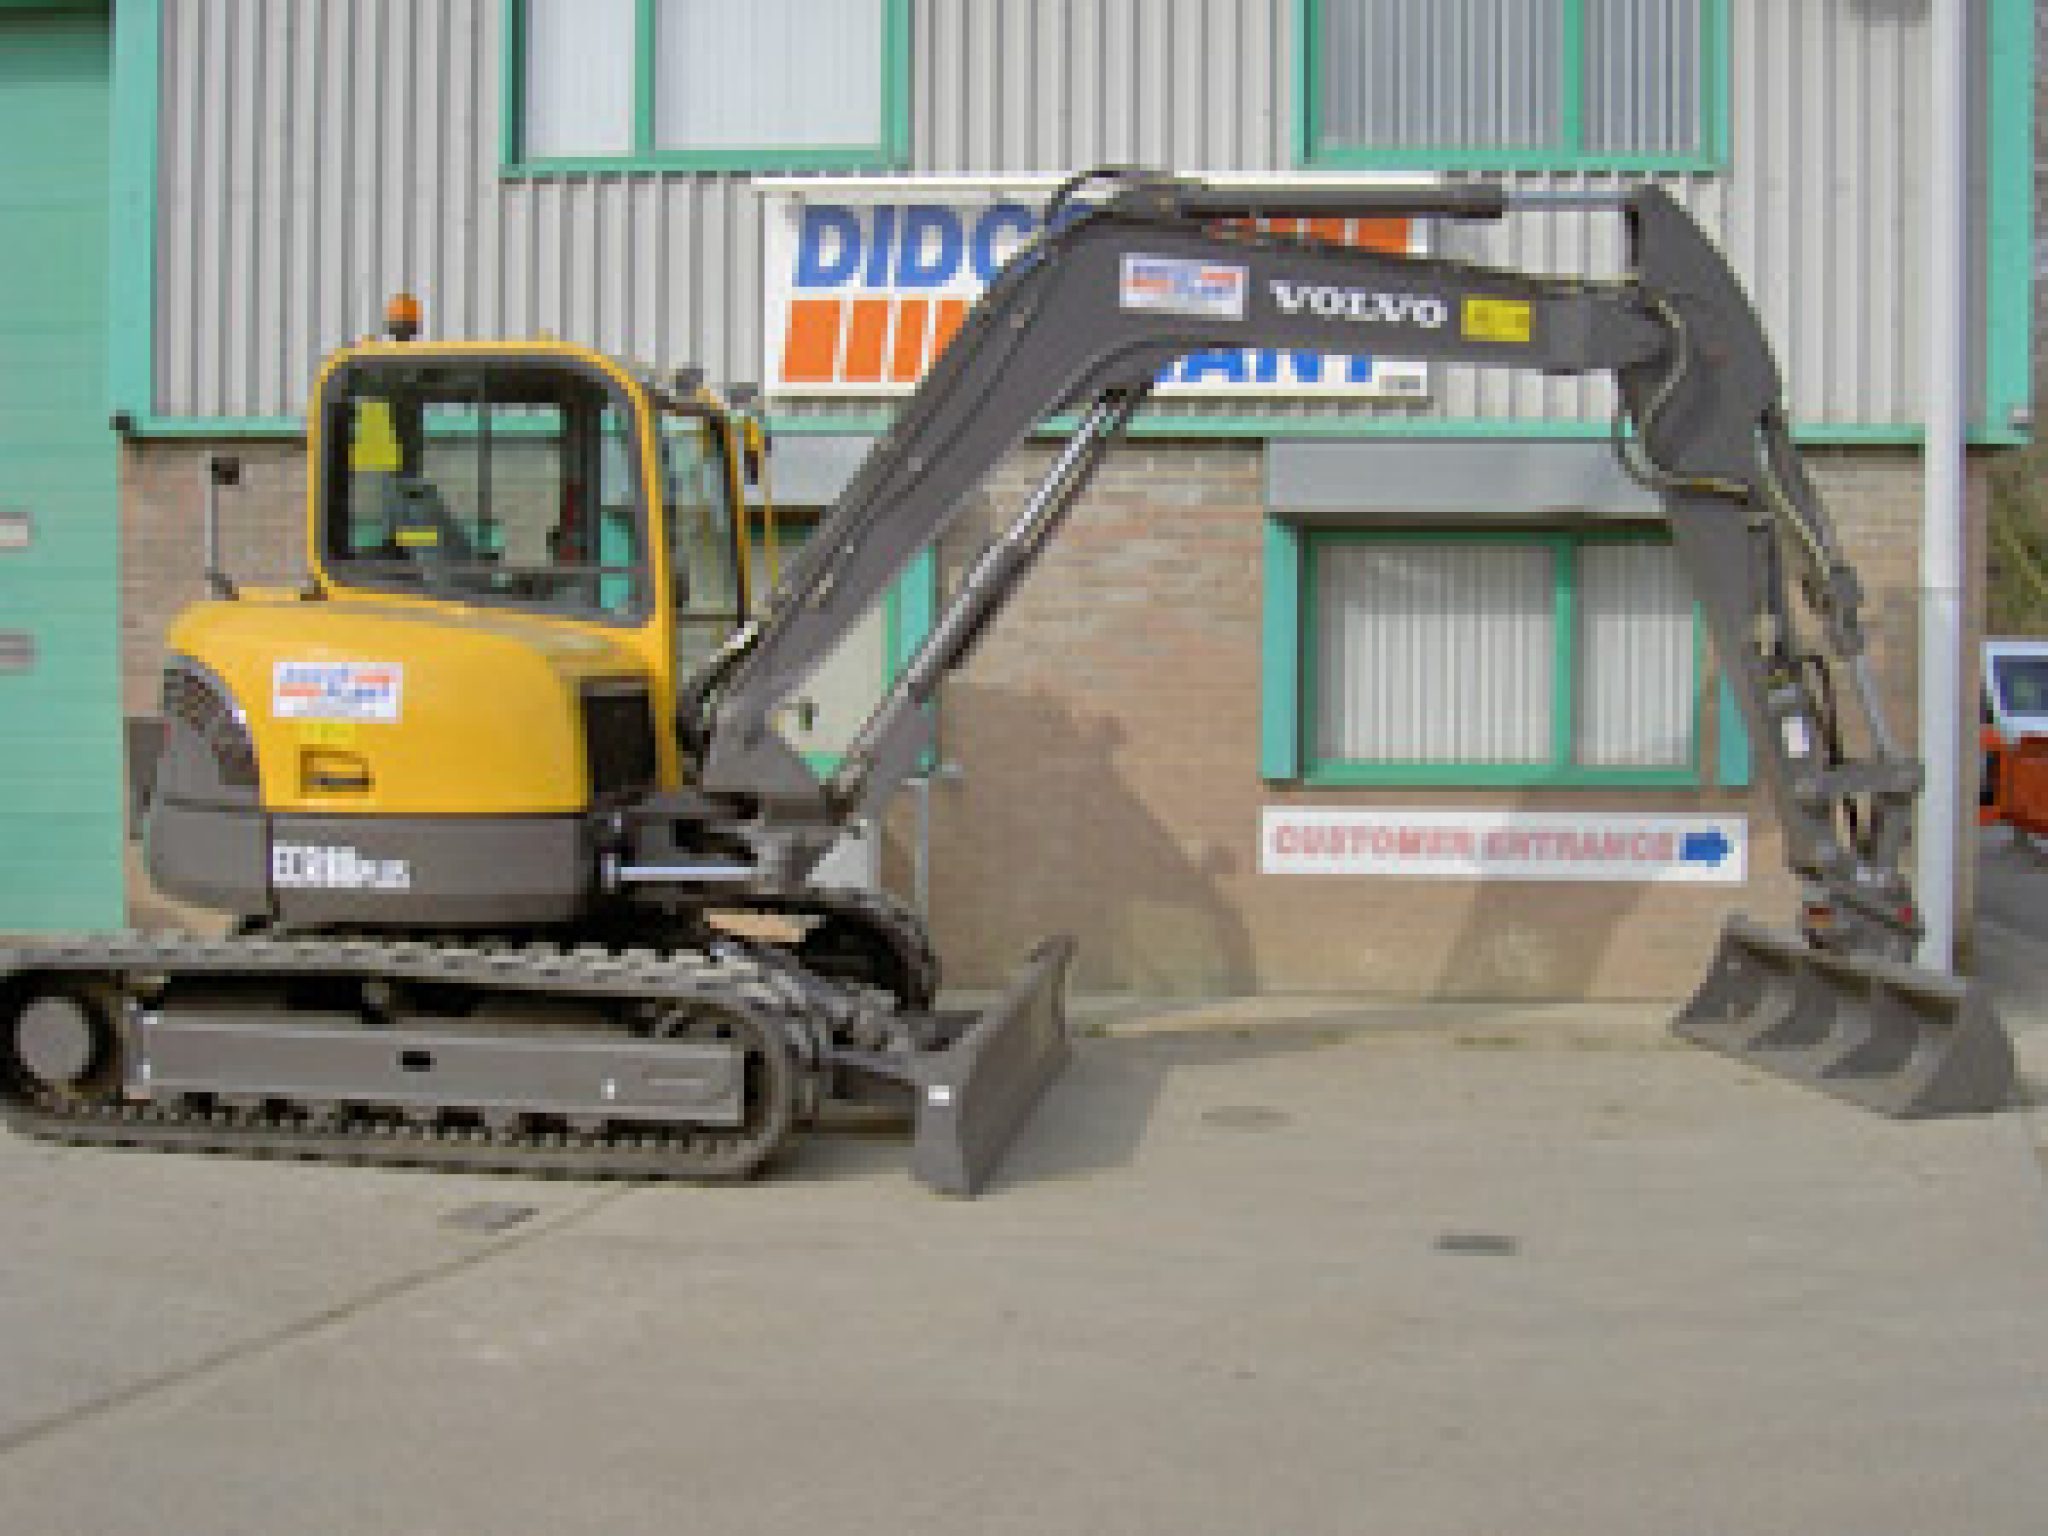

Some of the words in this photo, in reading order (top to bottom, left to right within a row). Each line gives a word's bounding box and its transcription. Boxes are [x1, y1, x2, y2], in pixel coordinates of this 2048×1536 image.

[797, 203, 1094, 288] DIDC
[1269, 281, 1448, 328] VOLVO
[1275, 824, 1476, 858] CUSTOMER
[1482, 827, 1675, 862] ENTRANCE
